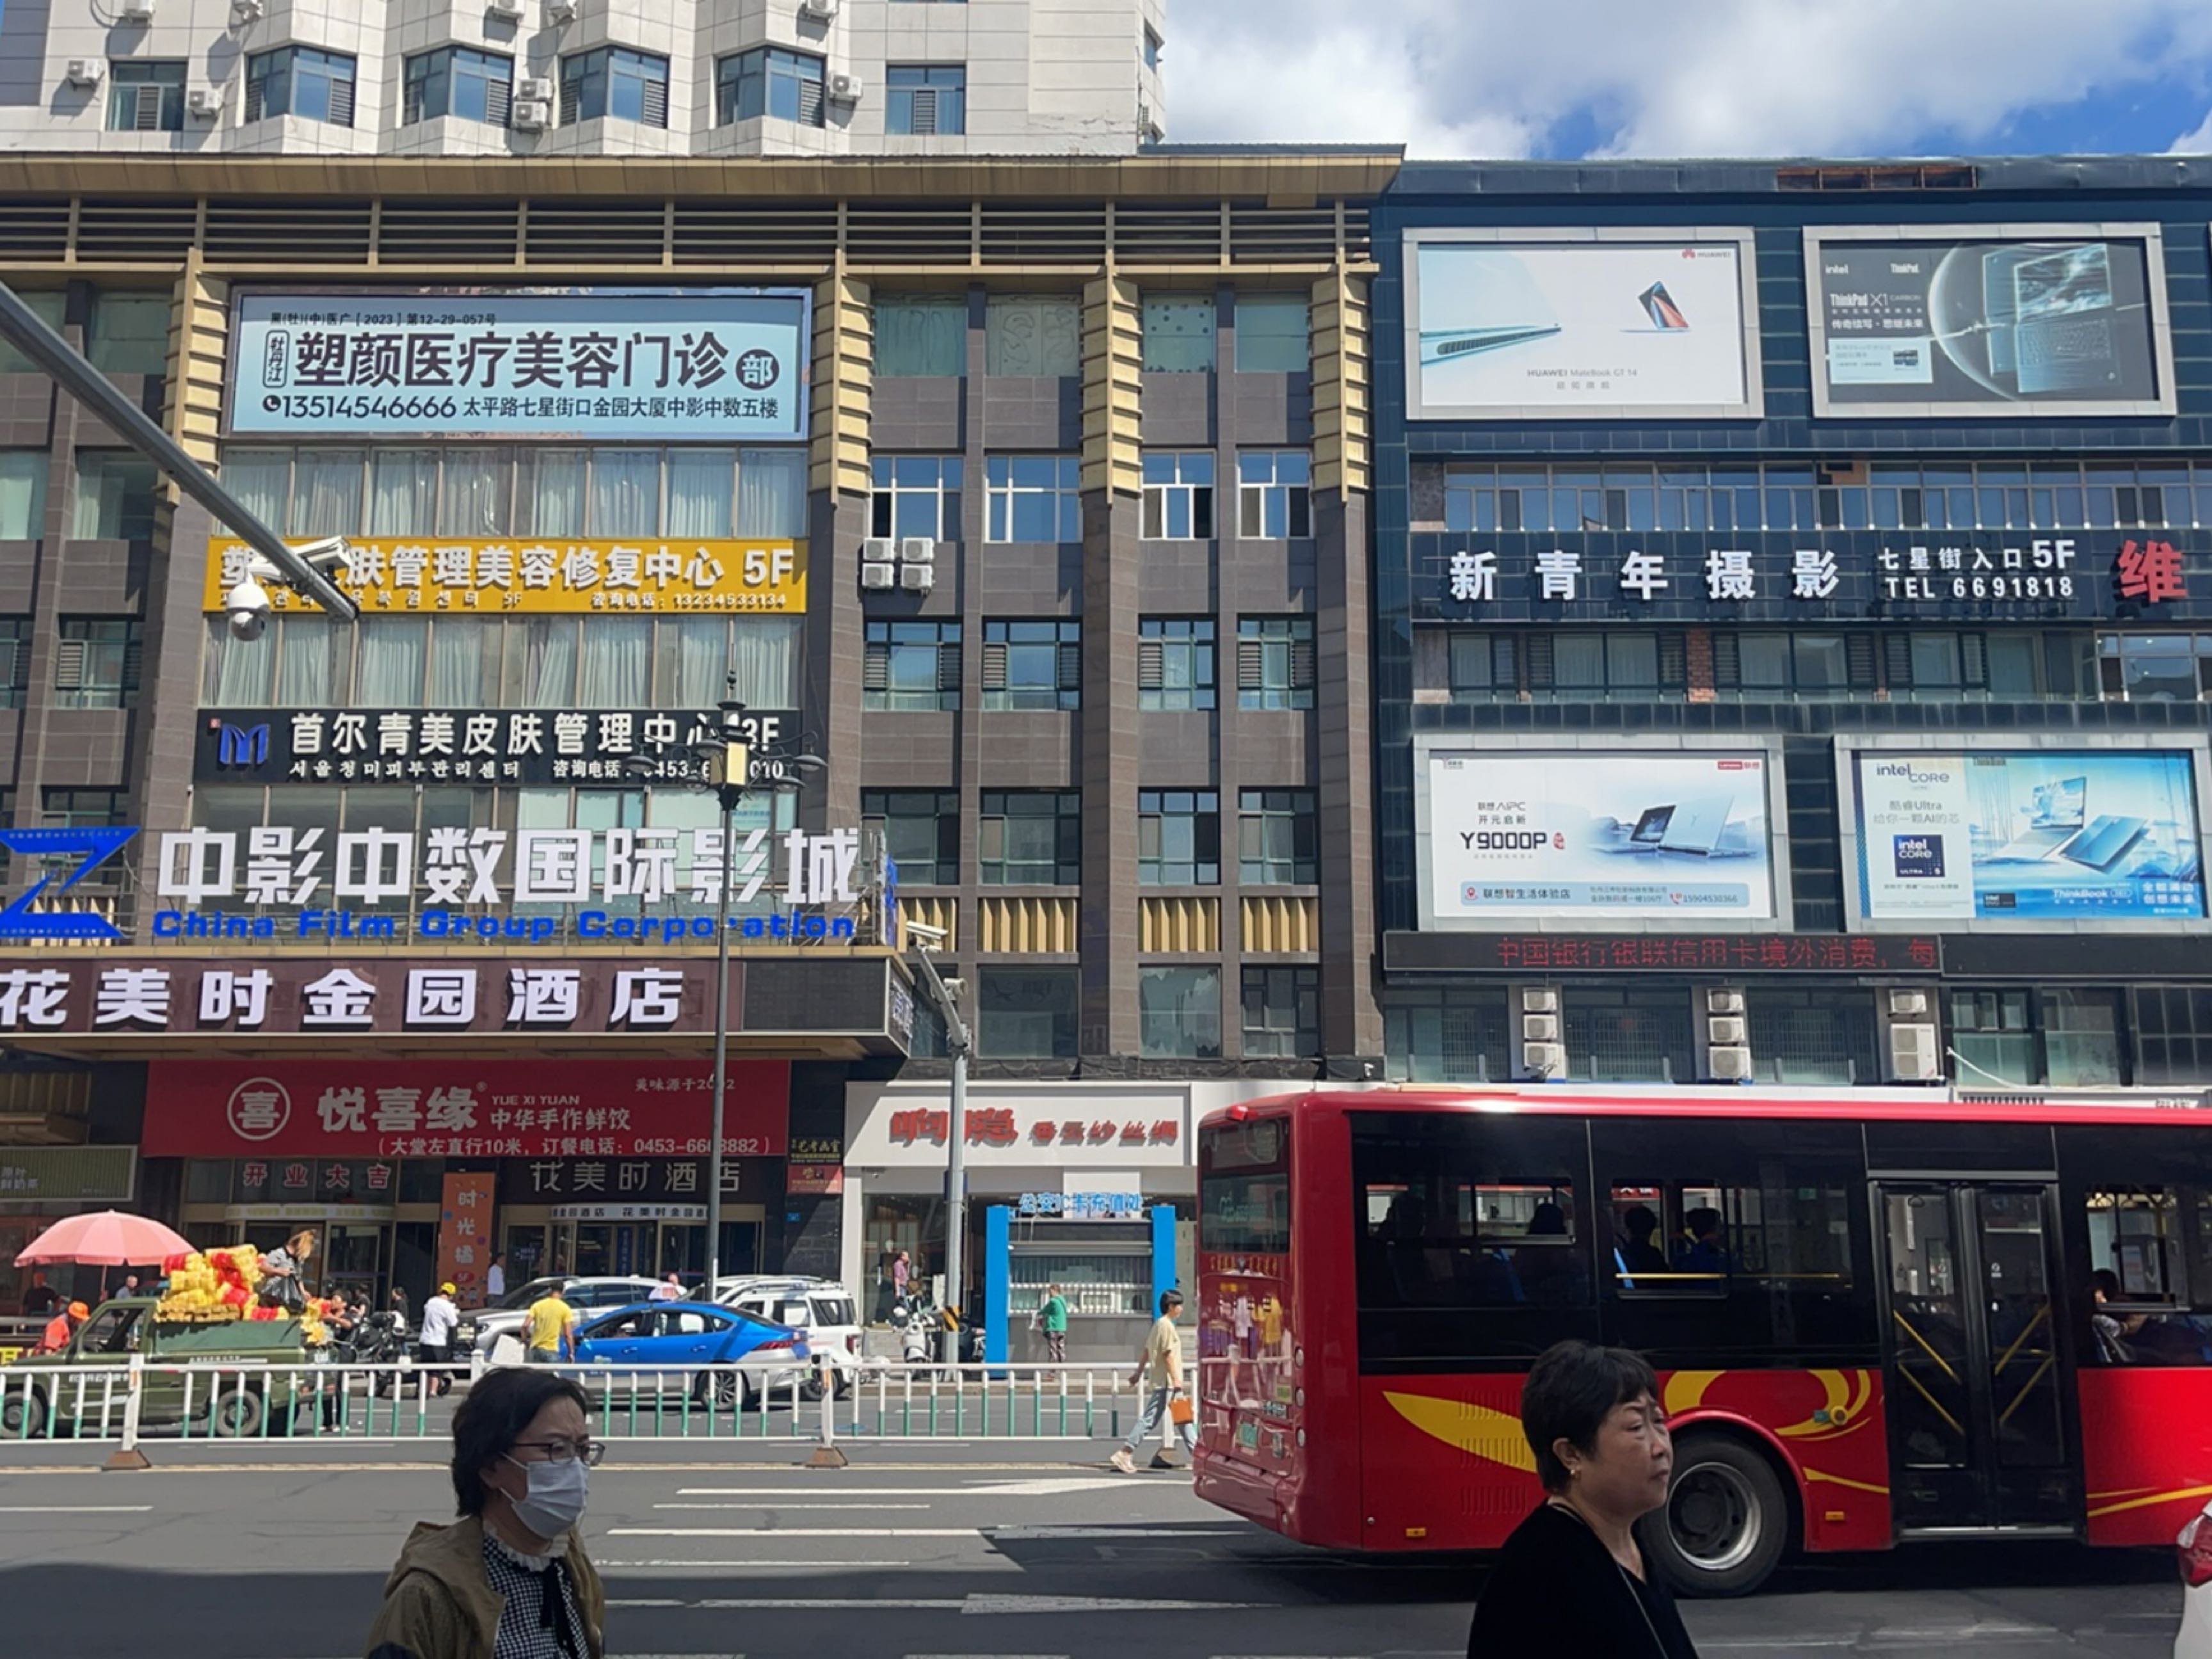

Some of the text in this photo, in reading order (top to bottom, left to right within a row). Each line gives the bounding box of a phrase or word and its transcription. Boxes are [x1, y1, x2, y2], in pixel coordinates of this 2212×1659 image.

[283, 395, 779, 420] 13514546666 太平路七星街口金园大厦中影中数五楼
[220, 545, 794, 588] 塑肤管理美容修复中心 5F
[1450, 550, 1839, 600] 新青年摄影
[2119, 540, 2188, 603] 维
[1886, 577, 2073, 598] TEL 6691818
[1876, 764, 1911, 776] intel
[1460, 831, 1548, 849] Y9000P
[1898, 838, 1928, 849] intel
[159, 826, 859, 904] 中影中数国际影城
[153, 911, 275, 938] China
[299, 910, 394, 937] Film
[420, 911, 554, 943] Group
[0, 968, 683, 1025] 花美时金园酒店
[635, 1077, 735, 1092] 美味源于202
[237, 1091, 280, 1128] 喜
[317, 1086, 479, 1132] 悦喜缘
[492, 1095, 580, 1105] YUE XI YUAN
[490, 1108, 632, 1132] 中华手作鲜饺
[243, 1162, 392, 1190] 开业大吉
